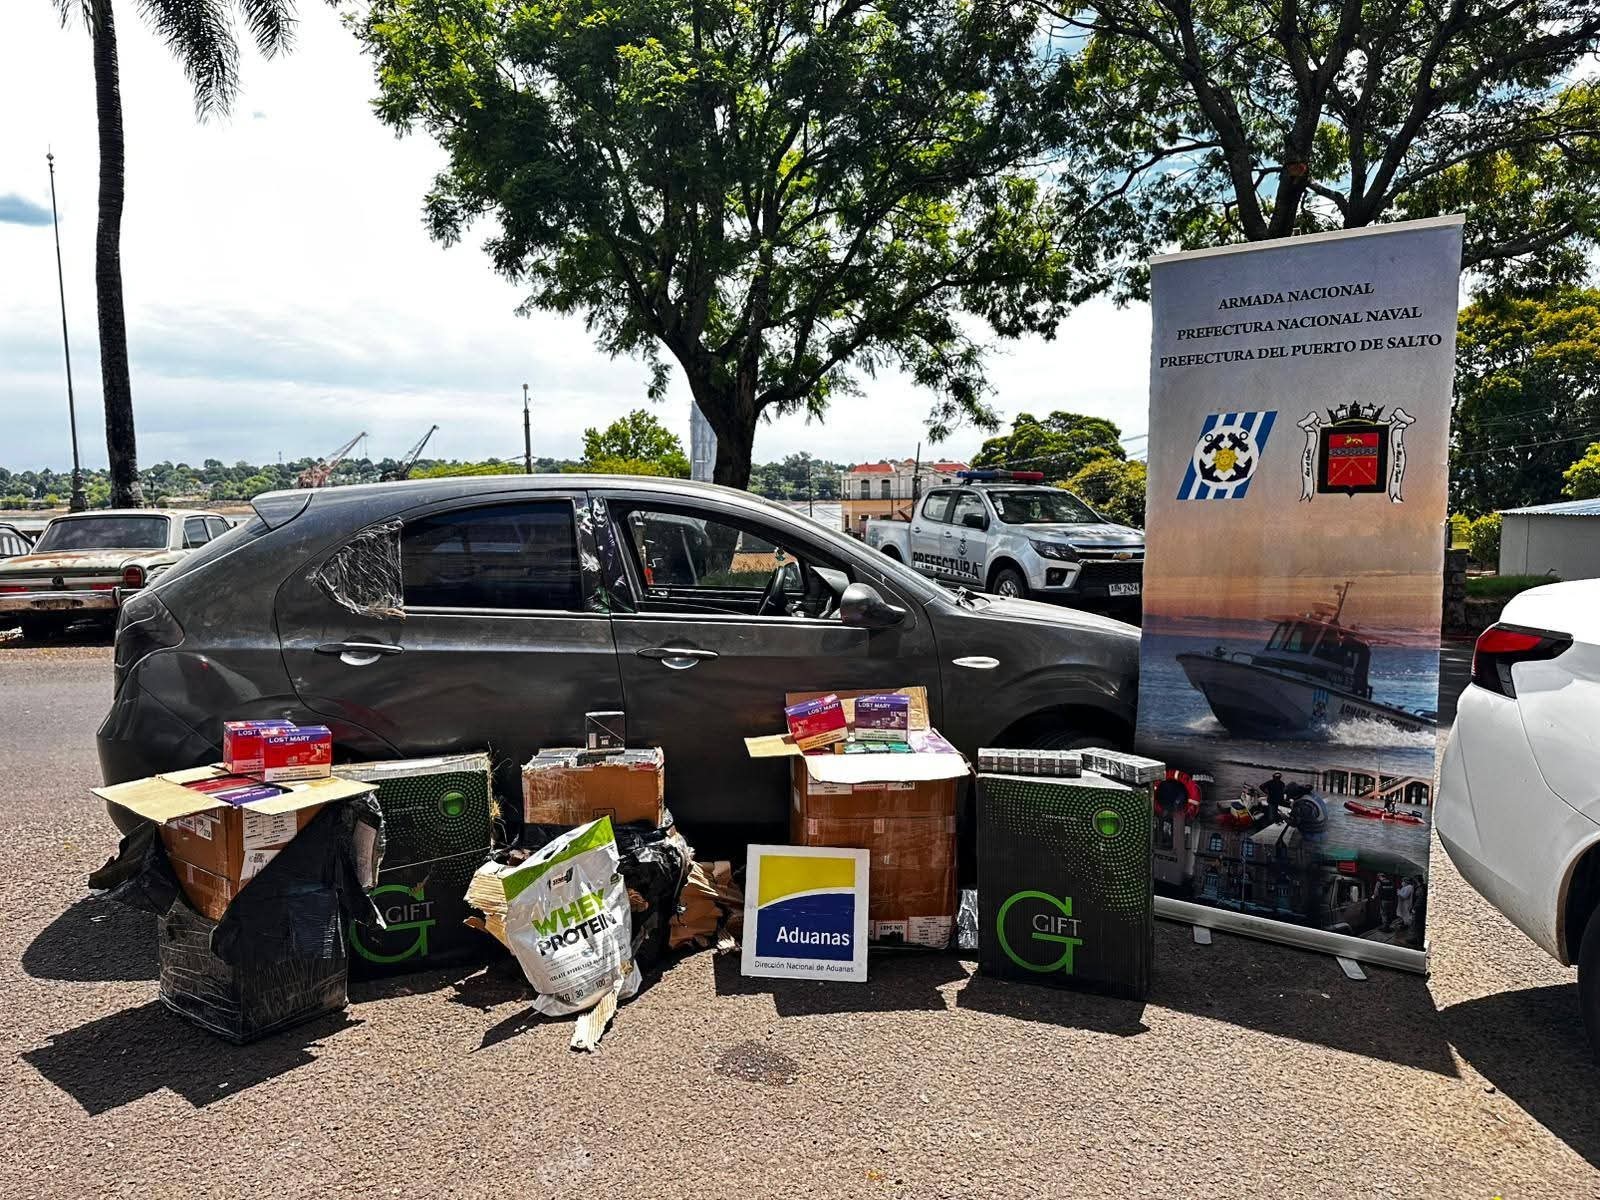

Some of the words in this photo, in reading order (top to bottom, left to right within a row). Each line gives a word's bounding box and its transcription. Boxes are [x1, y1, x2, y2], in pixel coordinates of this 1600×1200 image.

[1218, 293, 1285, 310] ARMADA
[1287, 283, 1375, 302] NACIONAL
[1176, 320, 1275, 341] PREFECTURA
[1277, 312, 1363, 331] NACIONAL
[1366, 306, 1422, 322] NAVAL
[1160, 349, 1254, 368] PREFECTURA
[1257, 346, 1289, 359] DEL
[1291, 341, 1357, 356] PUERTO
[1360, 339, 1384, 351] DE
[1387, 334, 1442, 350] SALTO
[912, 551, 980, 579] PREFECTURA
[808, 706, 823, 715] LOST
[823, 702, 839, 711] MARY
[386, 900, 435, 923] GIFT
[532, 888, 605, 936] WHEY
[537, 911, 617, 956] PROTEIN
[776, 926, 850, 946] Aduanas
[1032, 914, 1081, 937] GIFT
[754, 960, 785, 969] Dirección
[786, 962, 814, 970] Nacional
[826, 964, 854, 972] Aduanas
